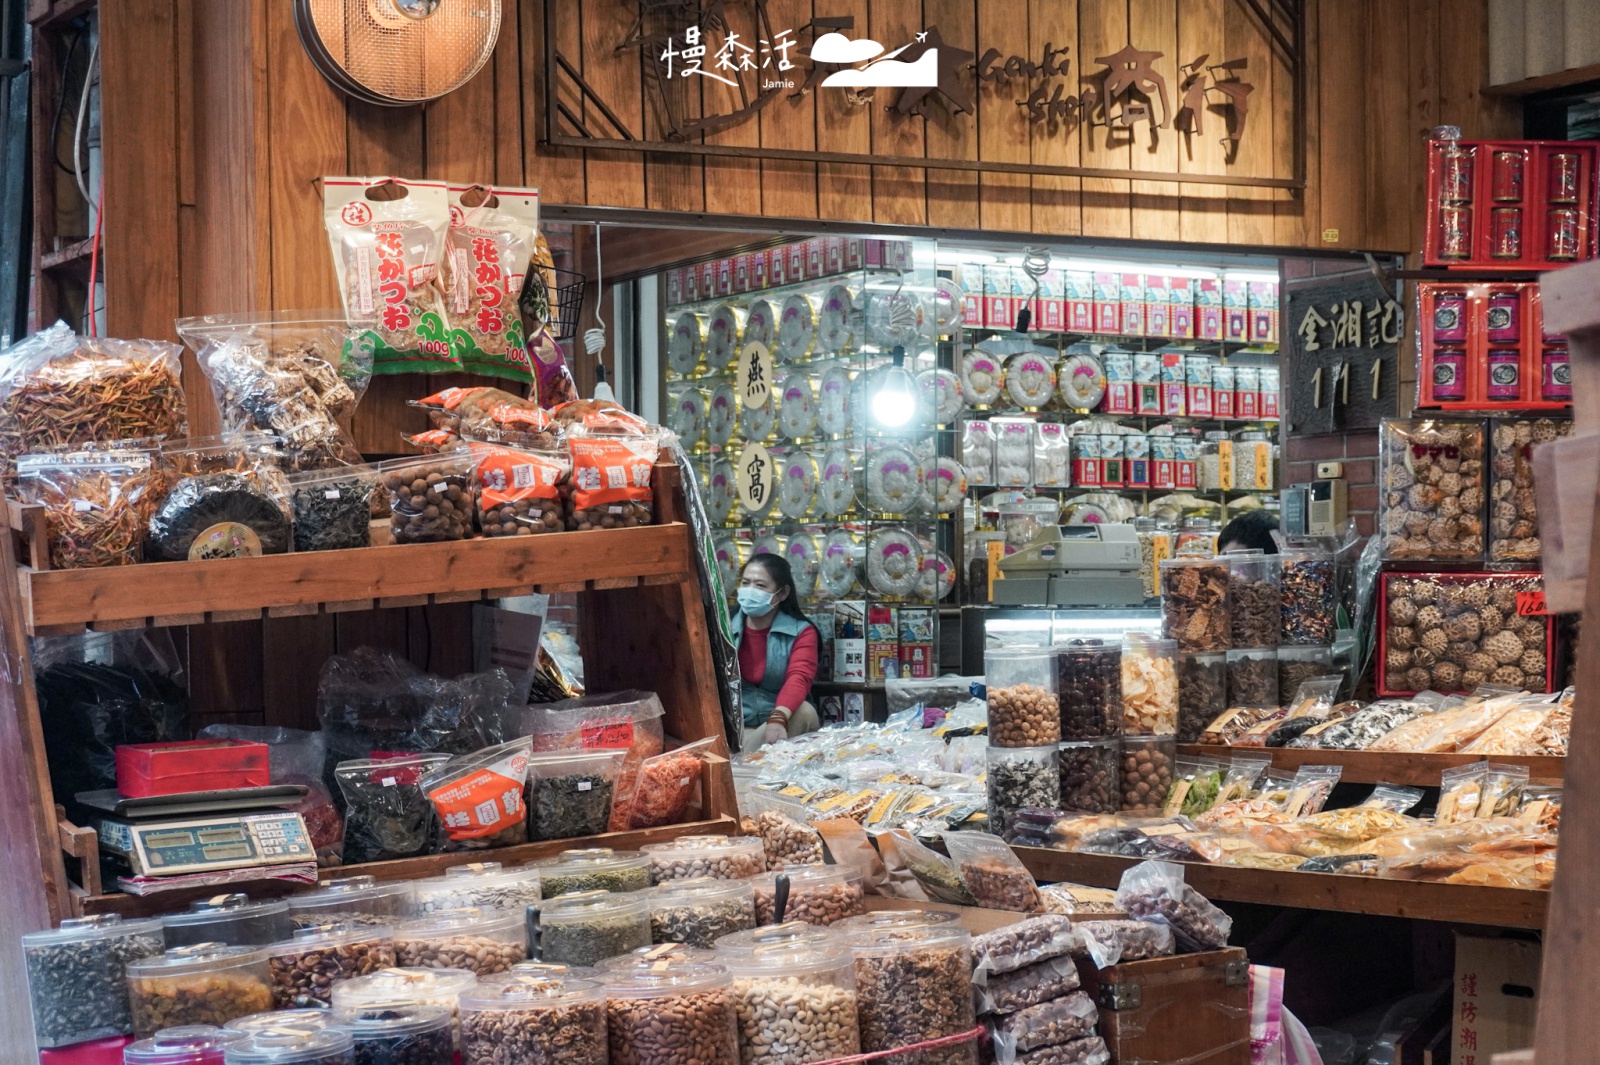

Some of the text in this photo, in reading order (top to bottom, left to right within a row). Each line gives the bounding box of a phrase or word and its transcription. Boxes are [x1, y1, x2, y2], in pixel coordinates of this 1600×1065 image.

[1094, 44, 1255, 140] 商行
[375, 232, 411, 332] 花かつお
[471, 237, 504, 335] 花かつお
[1298, 299, 1400, 352] 金湘記
[418, 341, 450, 357] 100g
[747, 352, 766, 398] 燕
[1411, 444, 1459, 460] ヤマセ
[577, 463, 651, 491] 桂圓乾
[746, 454, 766, 504] 窩
[1519, 601, 1548, 616] 160
[445, 787, 521, 828] 桂圓乾
